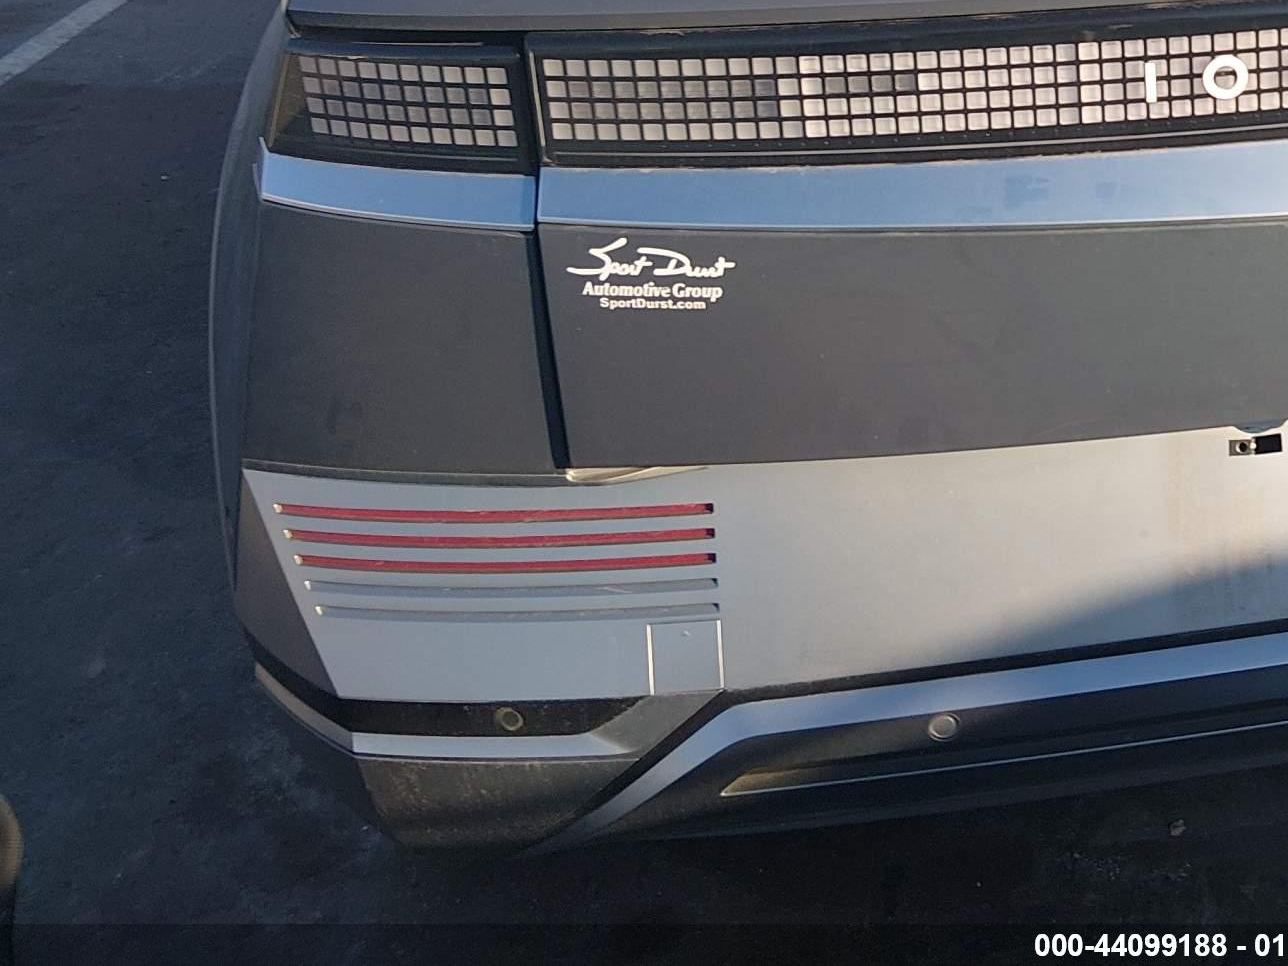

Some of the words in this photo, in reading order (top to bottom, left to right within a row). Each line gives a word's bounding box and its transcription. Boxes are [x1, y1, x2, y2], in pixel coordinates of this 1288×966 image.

[566, 237, 653, 282] Sport
[582, 281, 671, 299] Automotive
[672, 282, 723, 302] Group
[599, 297, 707, 310] SportDurst.com
